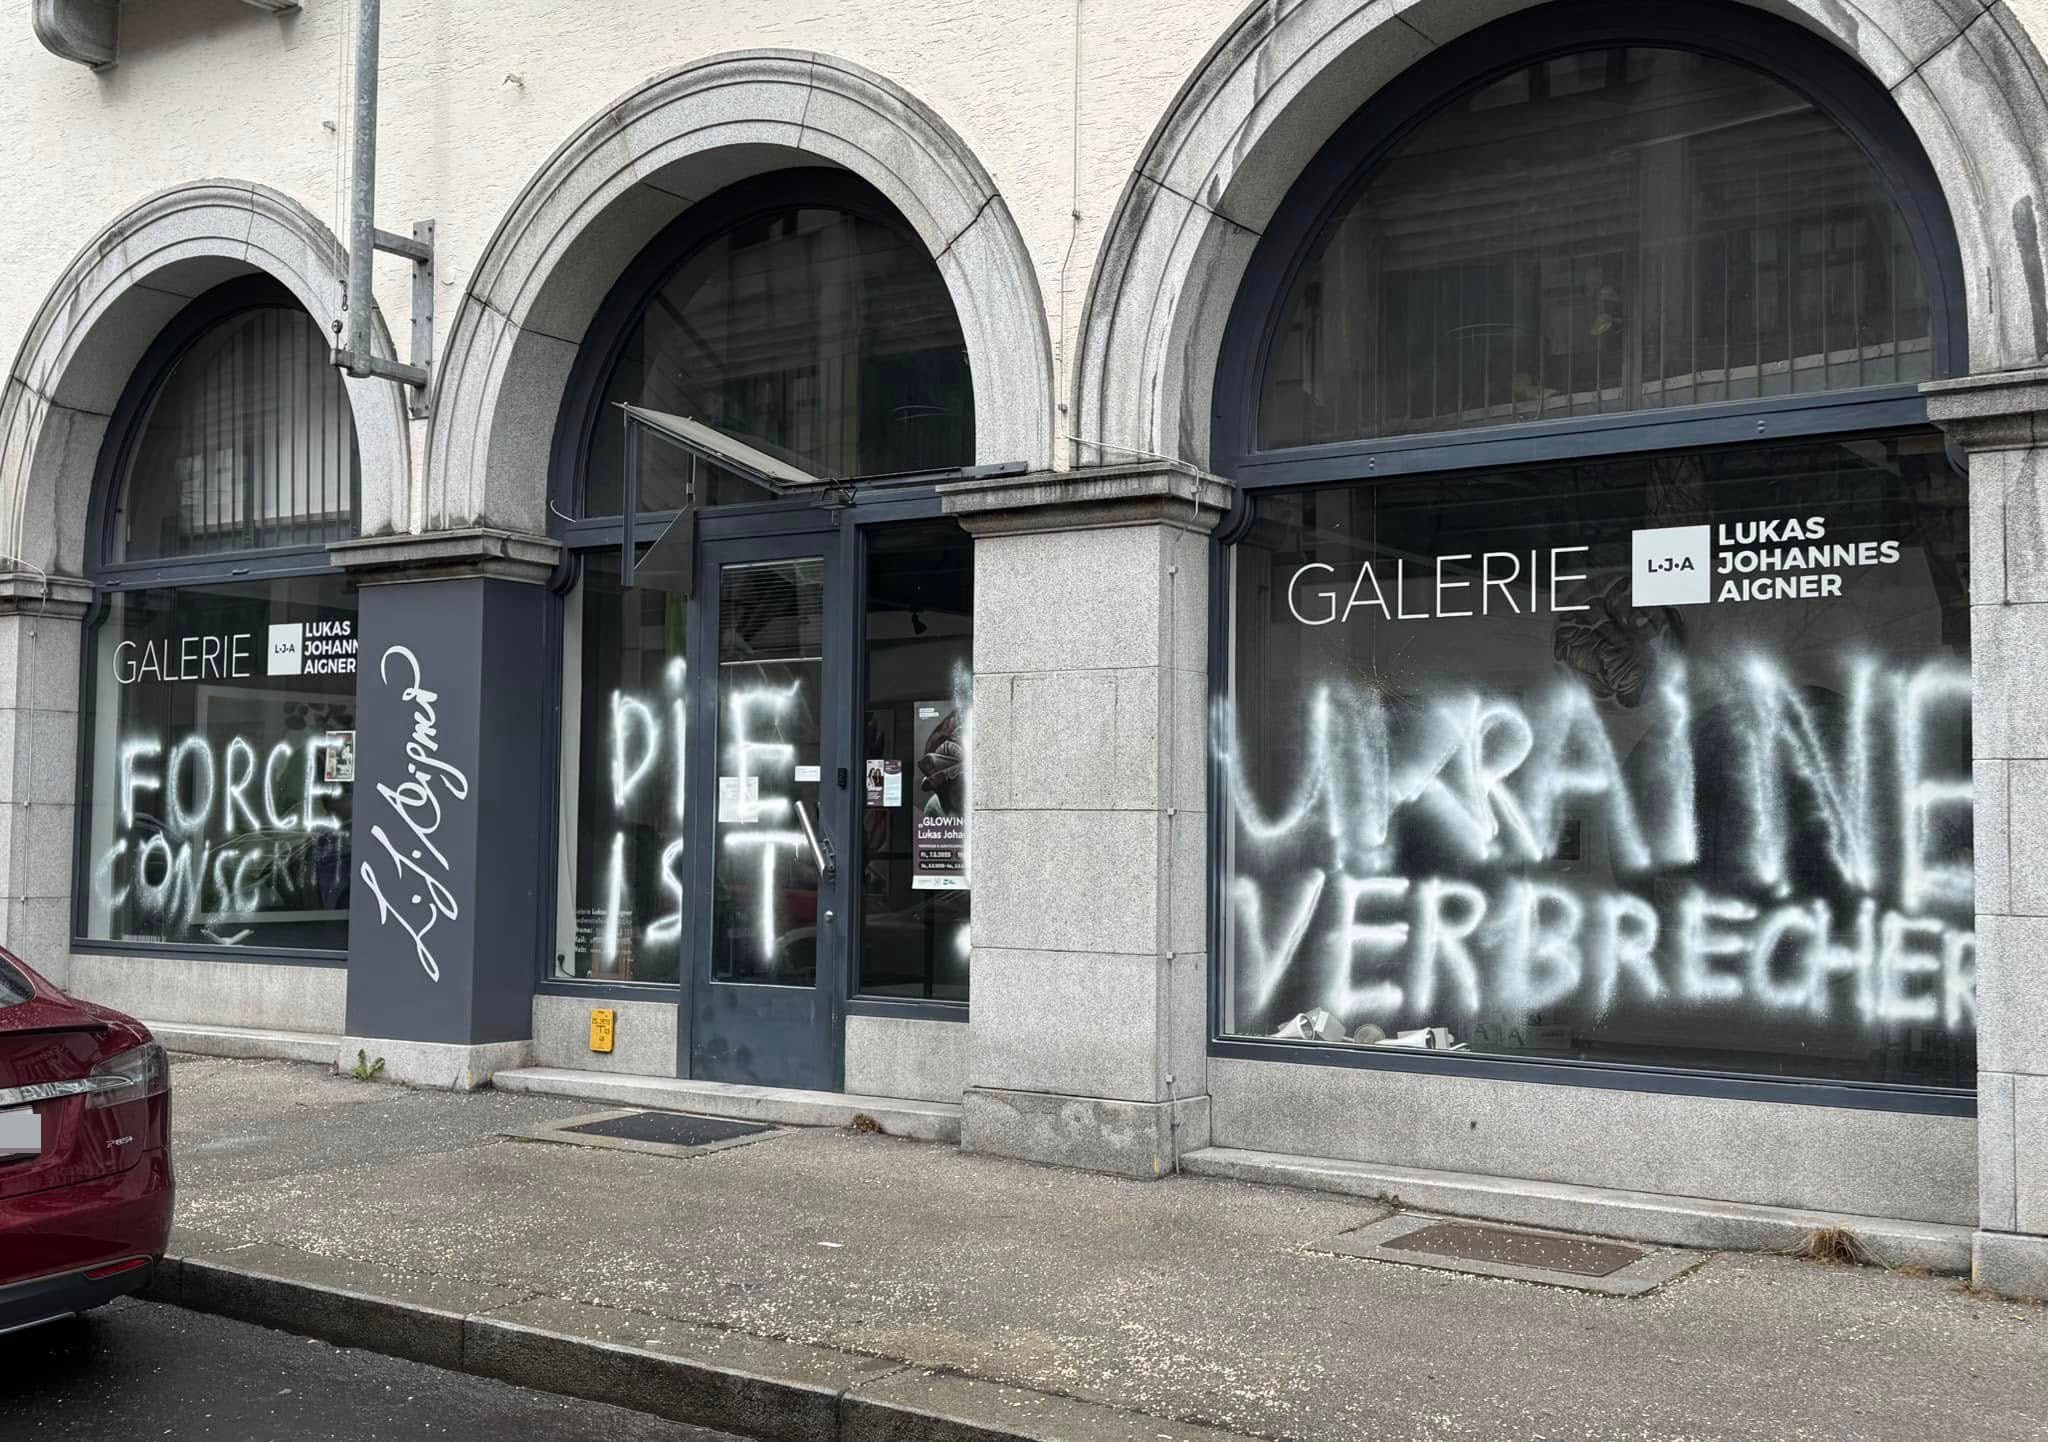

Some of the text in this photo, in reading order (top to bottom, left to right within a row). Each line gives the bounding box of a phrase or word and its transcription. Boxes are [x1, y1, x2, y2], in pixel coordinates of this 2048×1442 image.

[1717, 516, 1826, 547] LUKAS
[1717, 540, 1901, 576] JOHANNES
[1287, 545, 1591, 626] GALERIE
[1717, 573, 1843, 603] AIGNER
[305, 620, 351, 637] LUKAS
[112, 633, 251, 685] GALERIE
[304, 657, 357, 674] AIGNER
[119, 734, 346, 832] FORCE
[1211, 652, 1974, 912] UKRAINE
[918, 829, 941, 839] Lukas
[604, 831, 812, 968] IST
[1232, 863, 1976, 1031] VERBRECHER
